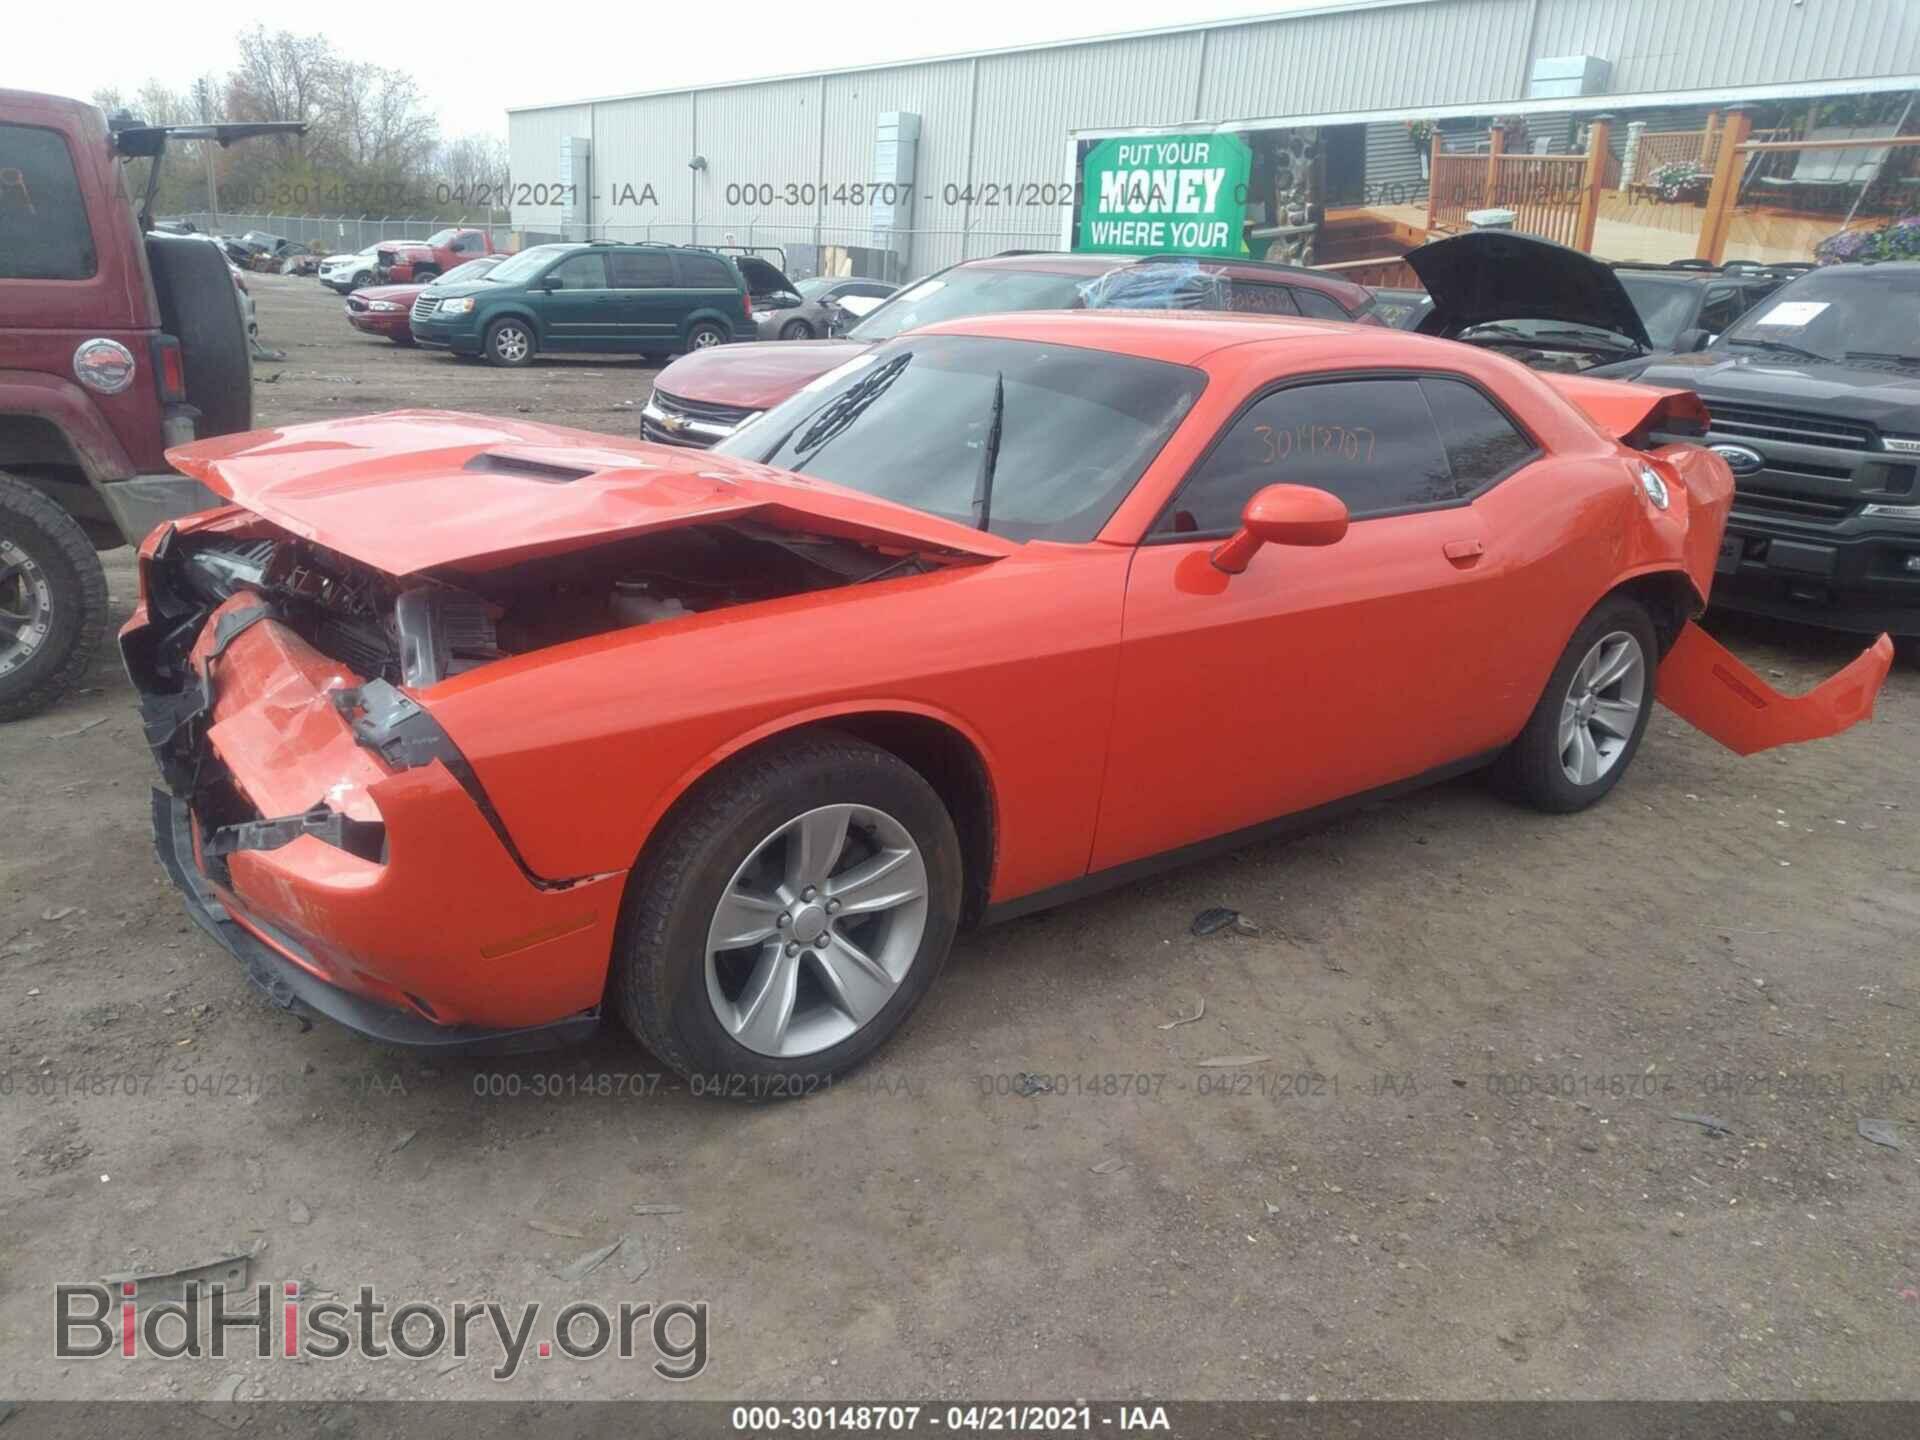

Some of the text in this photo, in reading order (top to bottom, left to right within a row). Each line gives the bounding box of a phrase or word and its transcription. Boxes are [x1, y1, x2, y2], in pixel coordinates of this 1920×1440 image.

[1118, 142, 1209, 166] PUT YOUR
[1099, 168, 1226, 214] MONEY
[1091, 221, 1229, 248] WHERE YOUR
